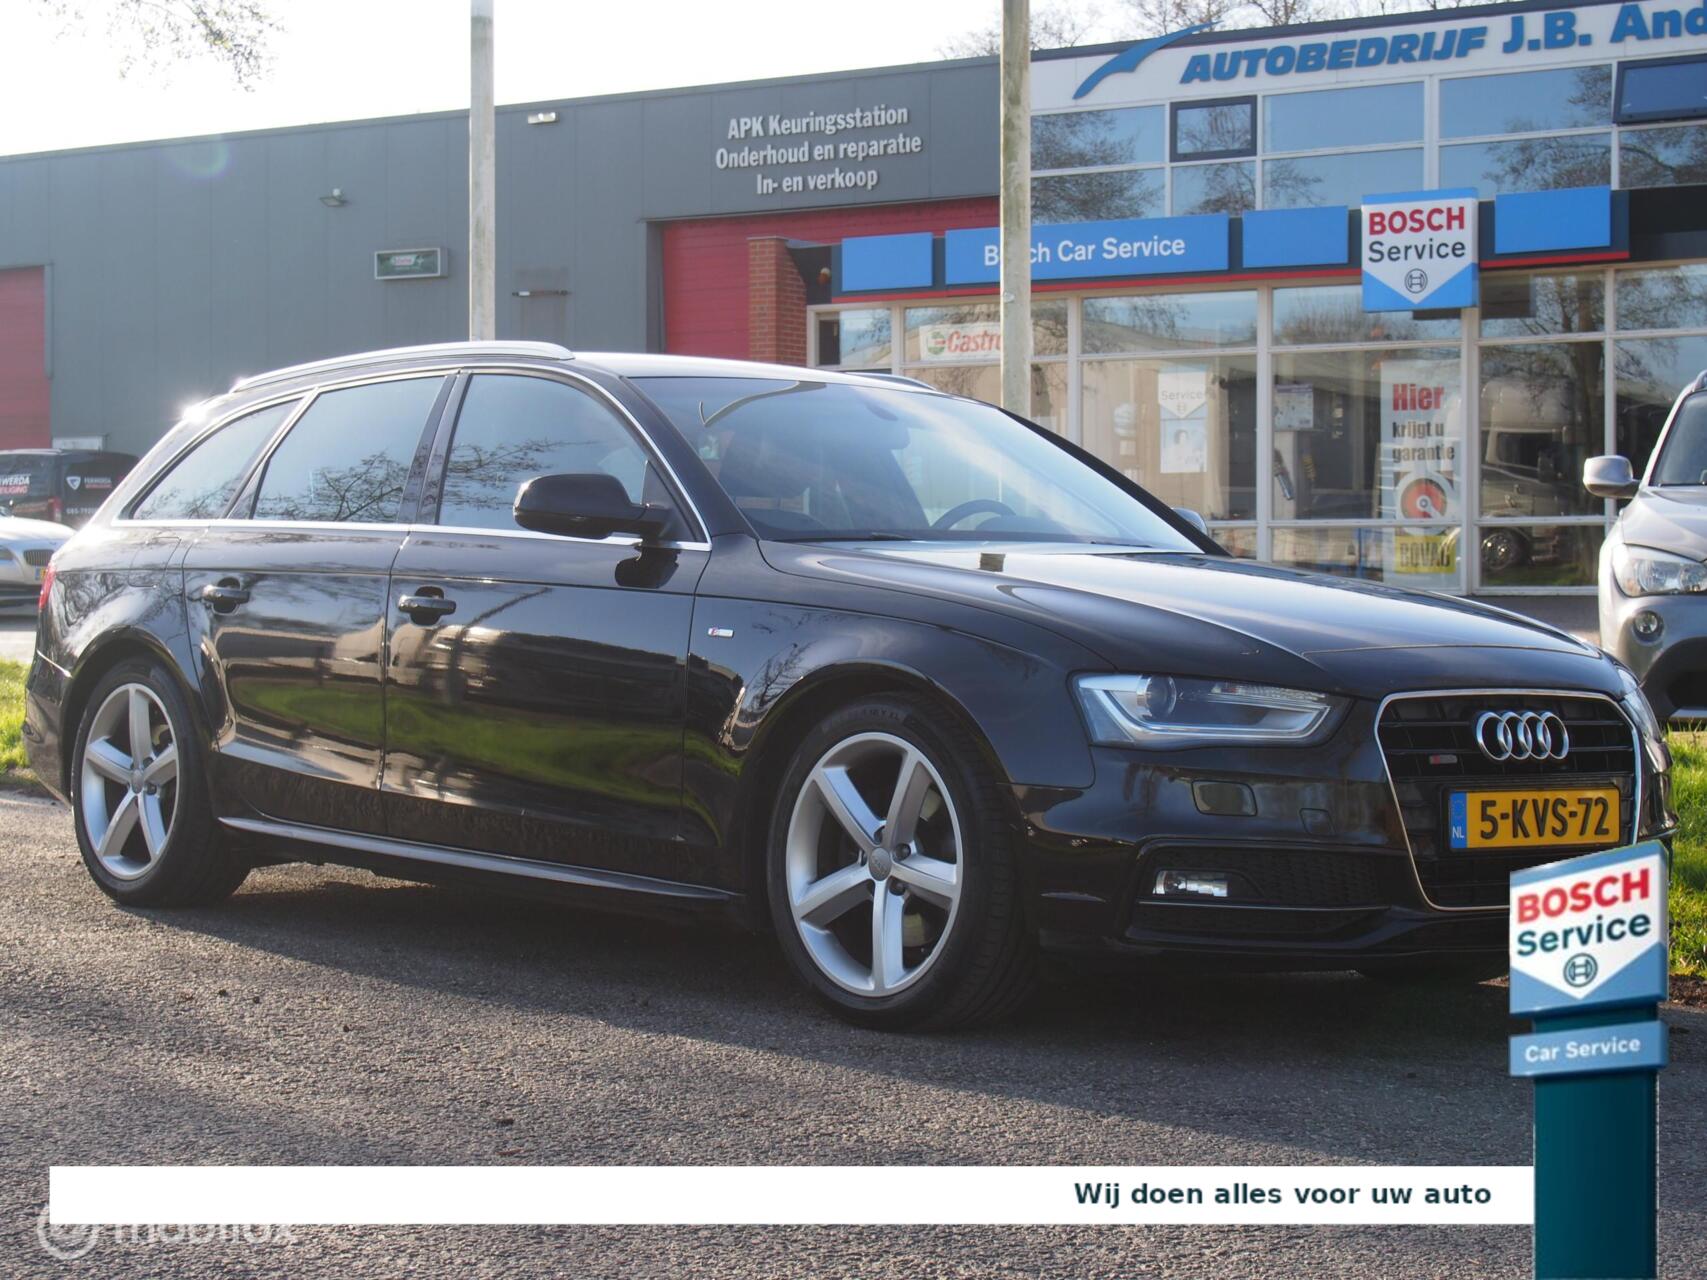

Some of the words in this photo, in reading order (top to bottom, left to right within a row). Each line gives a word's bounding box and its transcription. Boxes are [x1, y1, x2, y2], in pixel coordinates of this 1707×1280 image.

[1180, 26, 1488, 84] AUTOBEDRIJF
[1502, 11, 1592, 54] J.B.
[728, 116, 764, 139] APK
[768, 104, 909, 135] Keuringsstation
[715, 141, 810, 169] Onderhoud
[813, 144, 835, 161] en
[839, 133, 922, 162] reparatie
[756, 173, 778, 195] In-
[782, 174, 803, 192] en
[807, 167, 878, 190] verkoop
[1368, 206, 1465, 236] BOSCH
[984, 242, 1050, 266] Bch
[1057, 240, 1096, 262] Car
[1102, 236, 1186, 260] Service
[1368, 238, 1466, 263] Service
[946, 329, 1001, 353] Castro
[1161, 390, 1204, 401] Service
[1392, 383, 1445, 411] Hier
[1435, 422, 1444, 436] u
[1392, 444, 1455, 463] garantie
[1452, 825, 1465, 839] NL
[1480, 797, 1610, 840] 5-KVS-72
